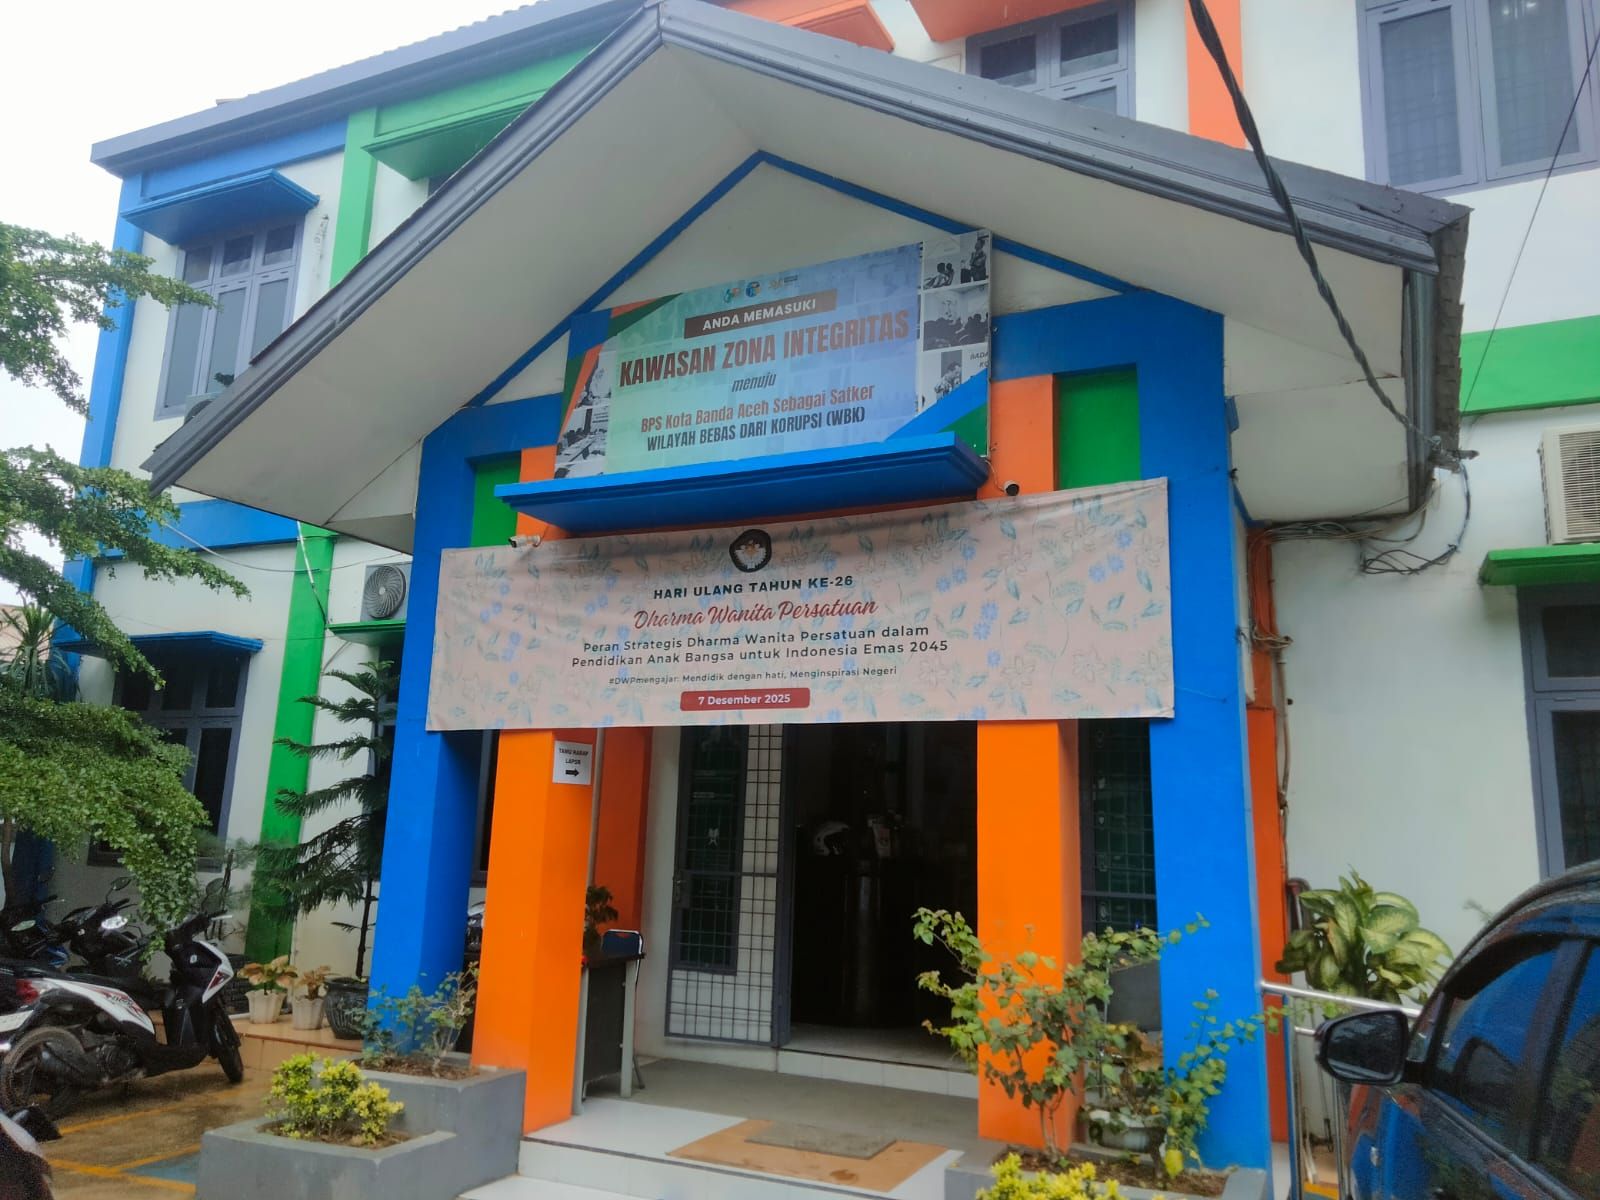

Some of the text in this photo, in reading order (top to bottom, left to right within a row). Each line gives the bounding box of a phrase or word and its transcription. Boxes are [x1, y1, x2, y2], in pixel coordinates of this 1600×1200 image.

[702, 298, 816, 331] ANDA MEMASUKI
[619, 310, 909, 387] KAWASAN ZONA INTEGRITAS
[731, 372, 776, 392] menuju
[641, 385, 875, 432] BPS Kota Banda Aceh Sebagai Satker
[647, 406, 866, 452] WILAYAH BEBAS DARI KORUPSI (WBK)
[653, 575, 853, 599] HARI ULANG TAHUN KE-26
[633, 598, 878, 630] Dharma Wanita Persatuan
[583, 625, 929, 653] Peran Strategis Dharma Wanita Persatuan dalam
[571, 640, 948, 667] Pendidikan Anak Bangsa untuk Indonesia Emas 2045
[682, 673, 724, 682] Mendidik
[727, 672, 762, 682] dengan
[765, 670, 786, 679] hati,
[790, 667, 860, 679] Menginspirasi
[863, 665, 897, 676] Negeri
[698, 693, 791, 705] 7 Desember 2025
